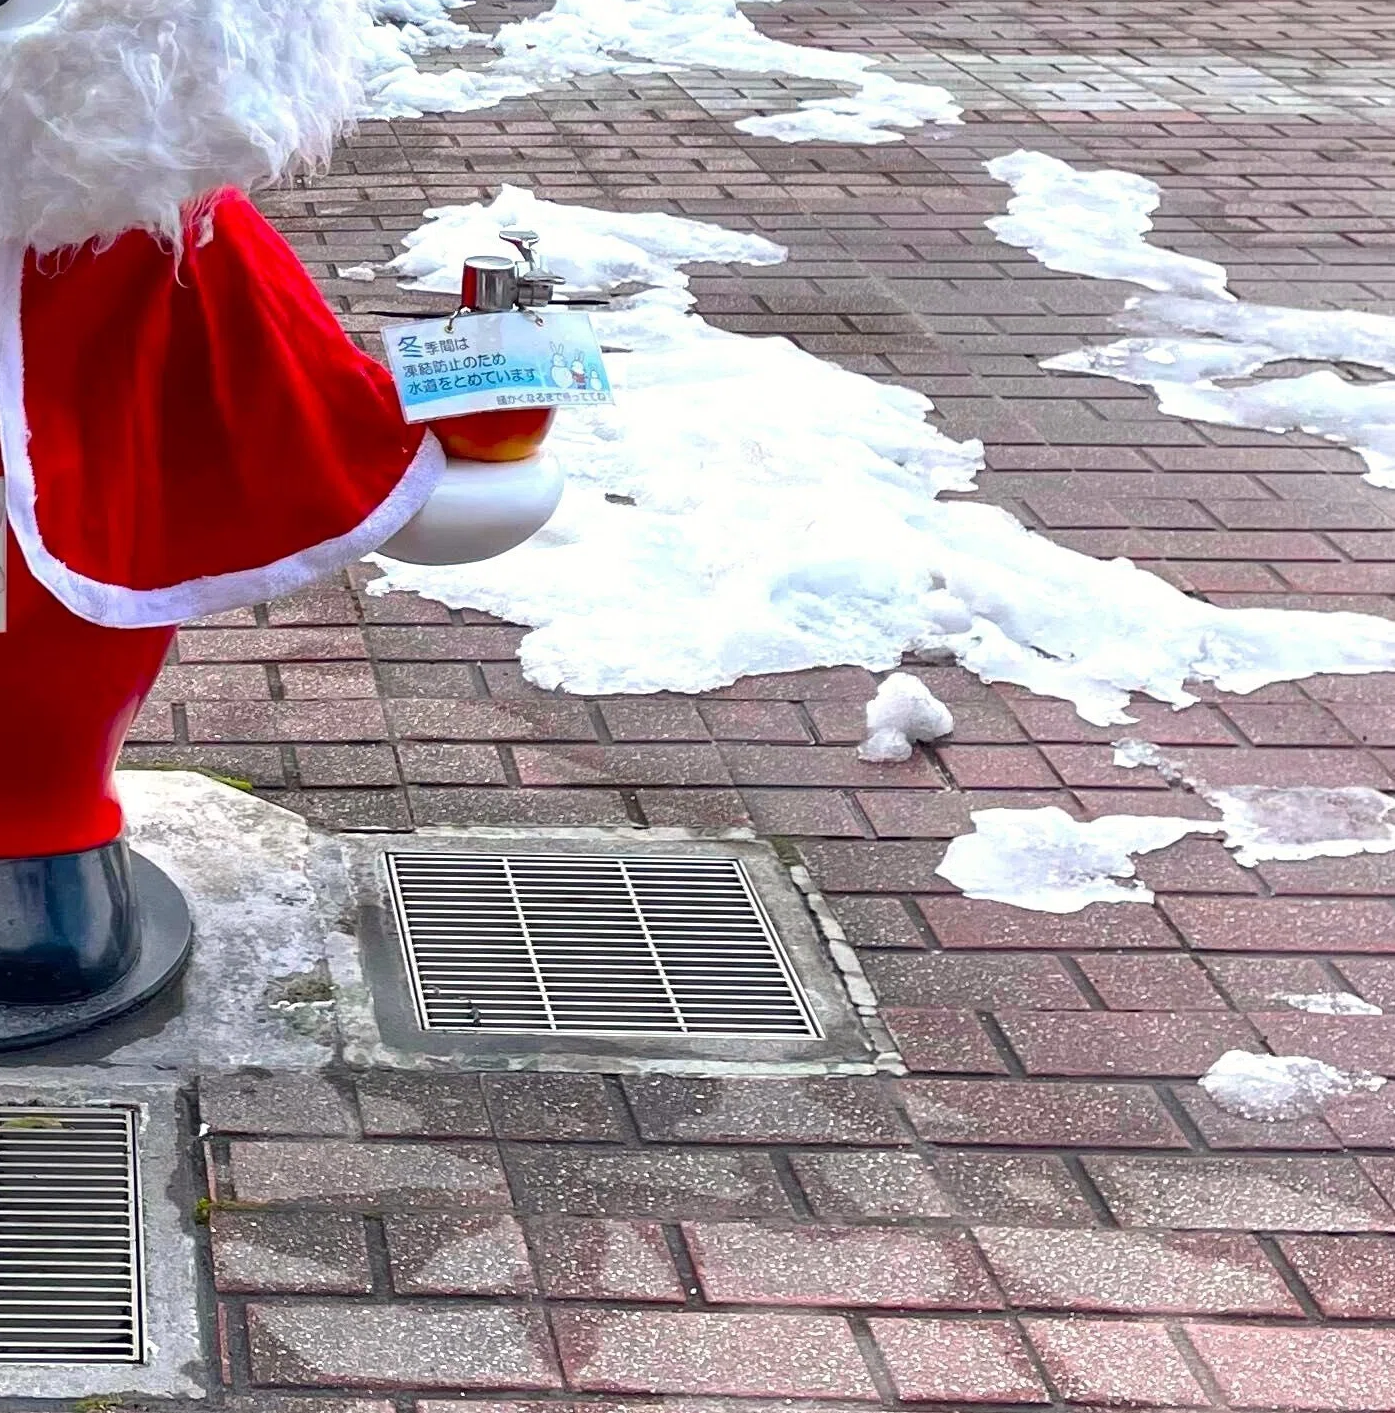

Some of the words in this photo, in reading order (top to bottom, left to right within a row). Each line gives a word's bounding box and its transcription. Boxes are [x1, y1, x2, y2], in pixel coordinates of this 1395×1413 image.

[398, 336, 469, 357] 冬季間は
[403, 353, 506, 377] 凍結防止のため
[408, 368, 535, 395] 水道をとめています
